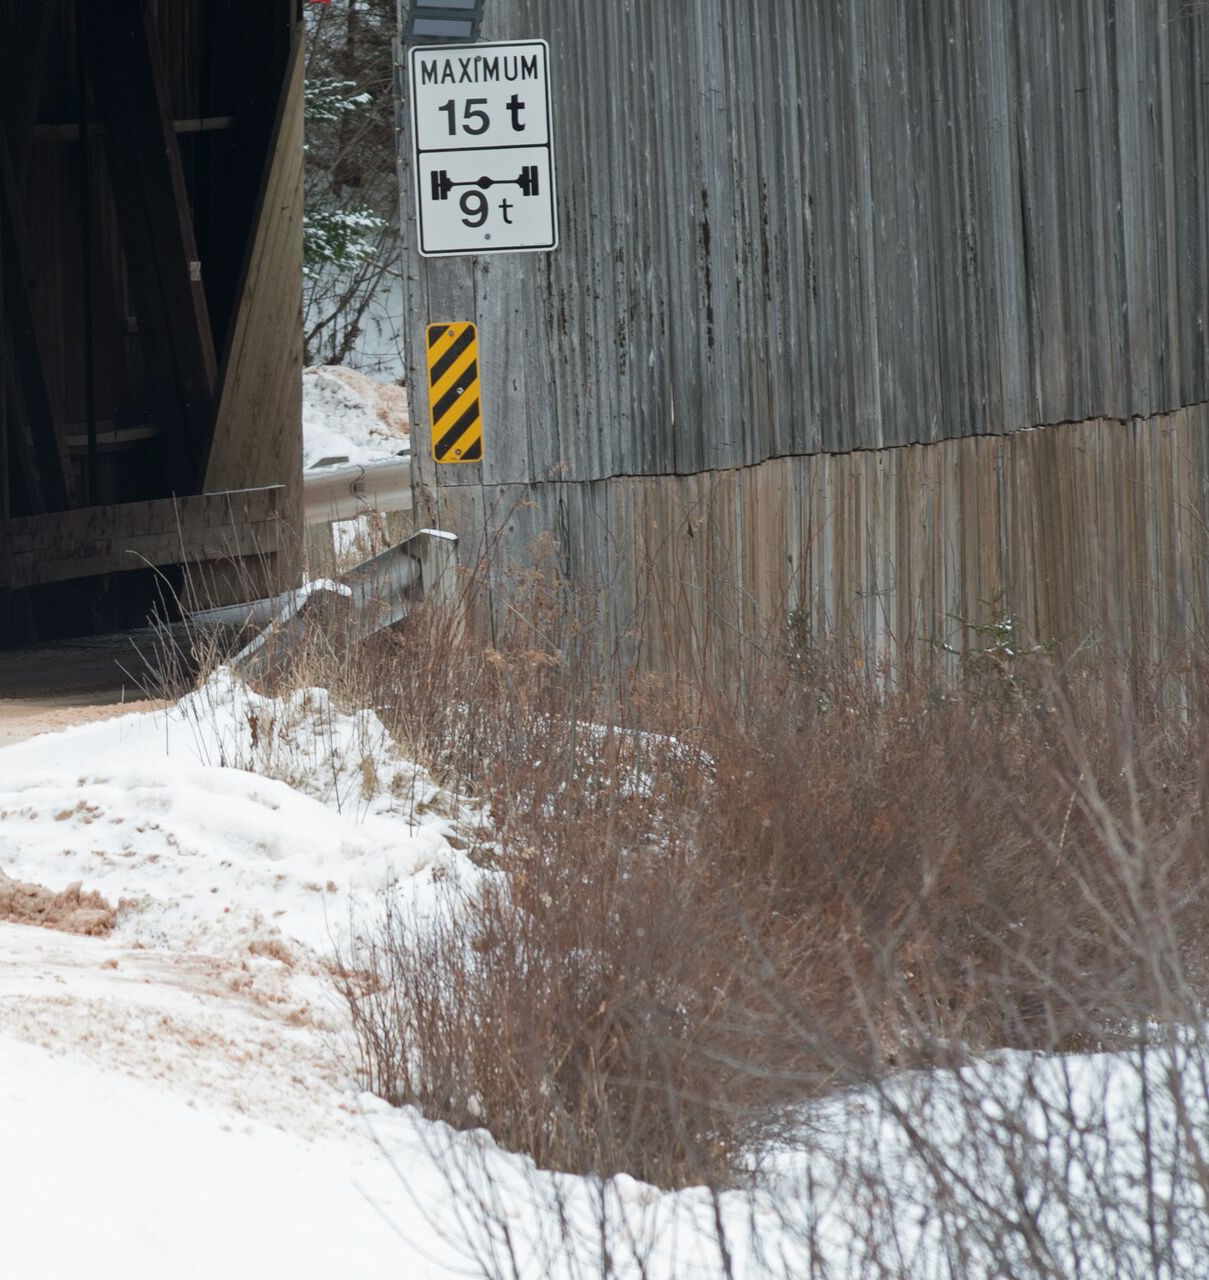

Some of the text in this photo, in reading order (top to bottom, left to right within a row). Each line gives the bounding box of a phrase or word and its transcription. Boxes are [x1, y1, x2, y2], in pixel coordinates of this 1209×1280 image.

[421, 55, 538, 84] MAXIMUM
[438, 93, 526, 135] 15 t
[459, 189, 514, 228] 9 t
